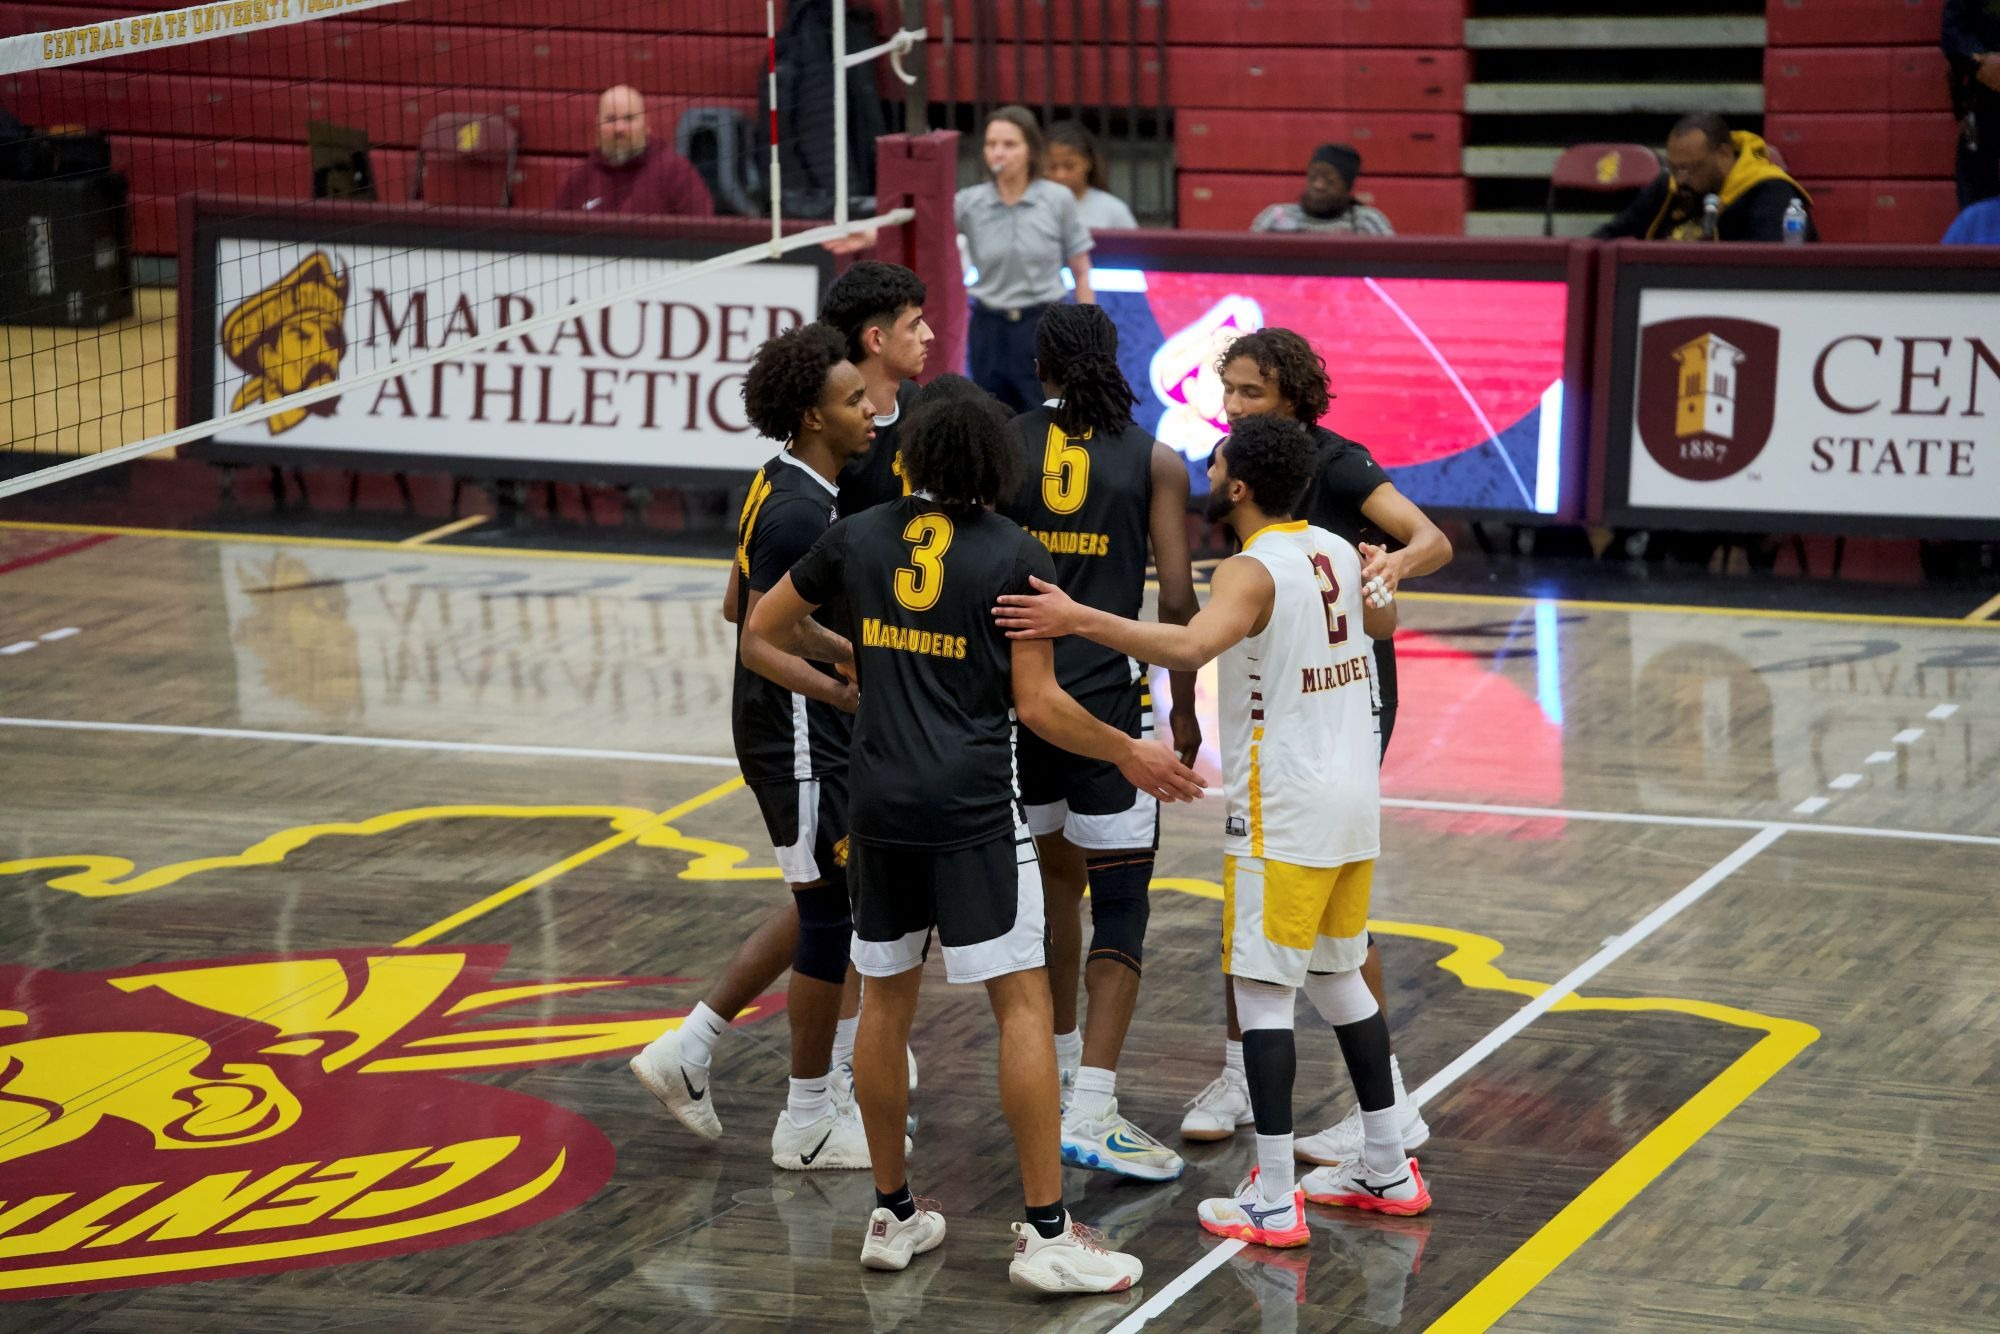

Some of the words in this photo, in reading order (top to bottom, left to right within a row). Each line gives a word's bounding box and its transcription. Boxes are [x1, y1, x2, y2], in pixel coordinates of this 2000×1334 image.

[43, 22, 126, 60] CENTRAL
[130, 12, 187, 45] STATE
[191, 0, 290, 34] UNIVERSITY
[1042, 422, 1093, 515] 5
[1680, 439, 1727, 464] 1887
[1810, 436, 1976, 477] STATE
[894, 512, 954, 612] 3
[1307, 551, 1349, 649] 2
[863, 618, 967, 660] MARAUDERS
[0, 1135, 521, 1259] CENT
